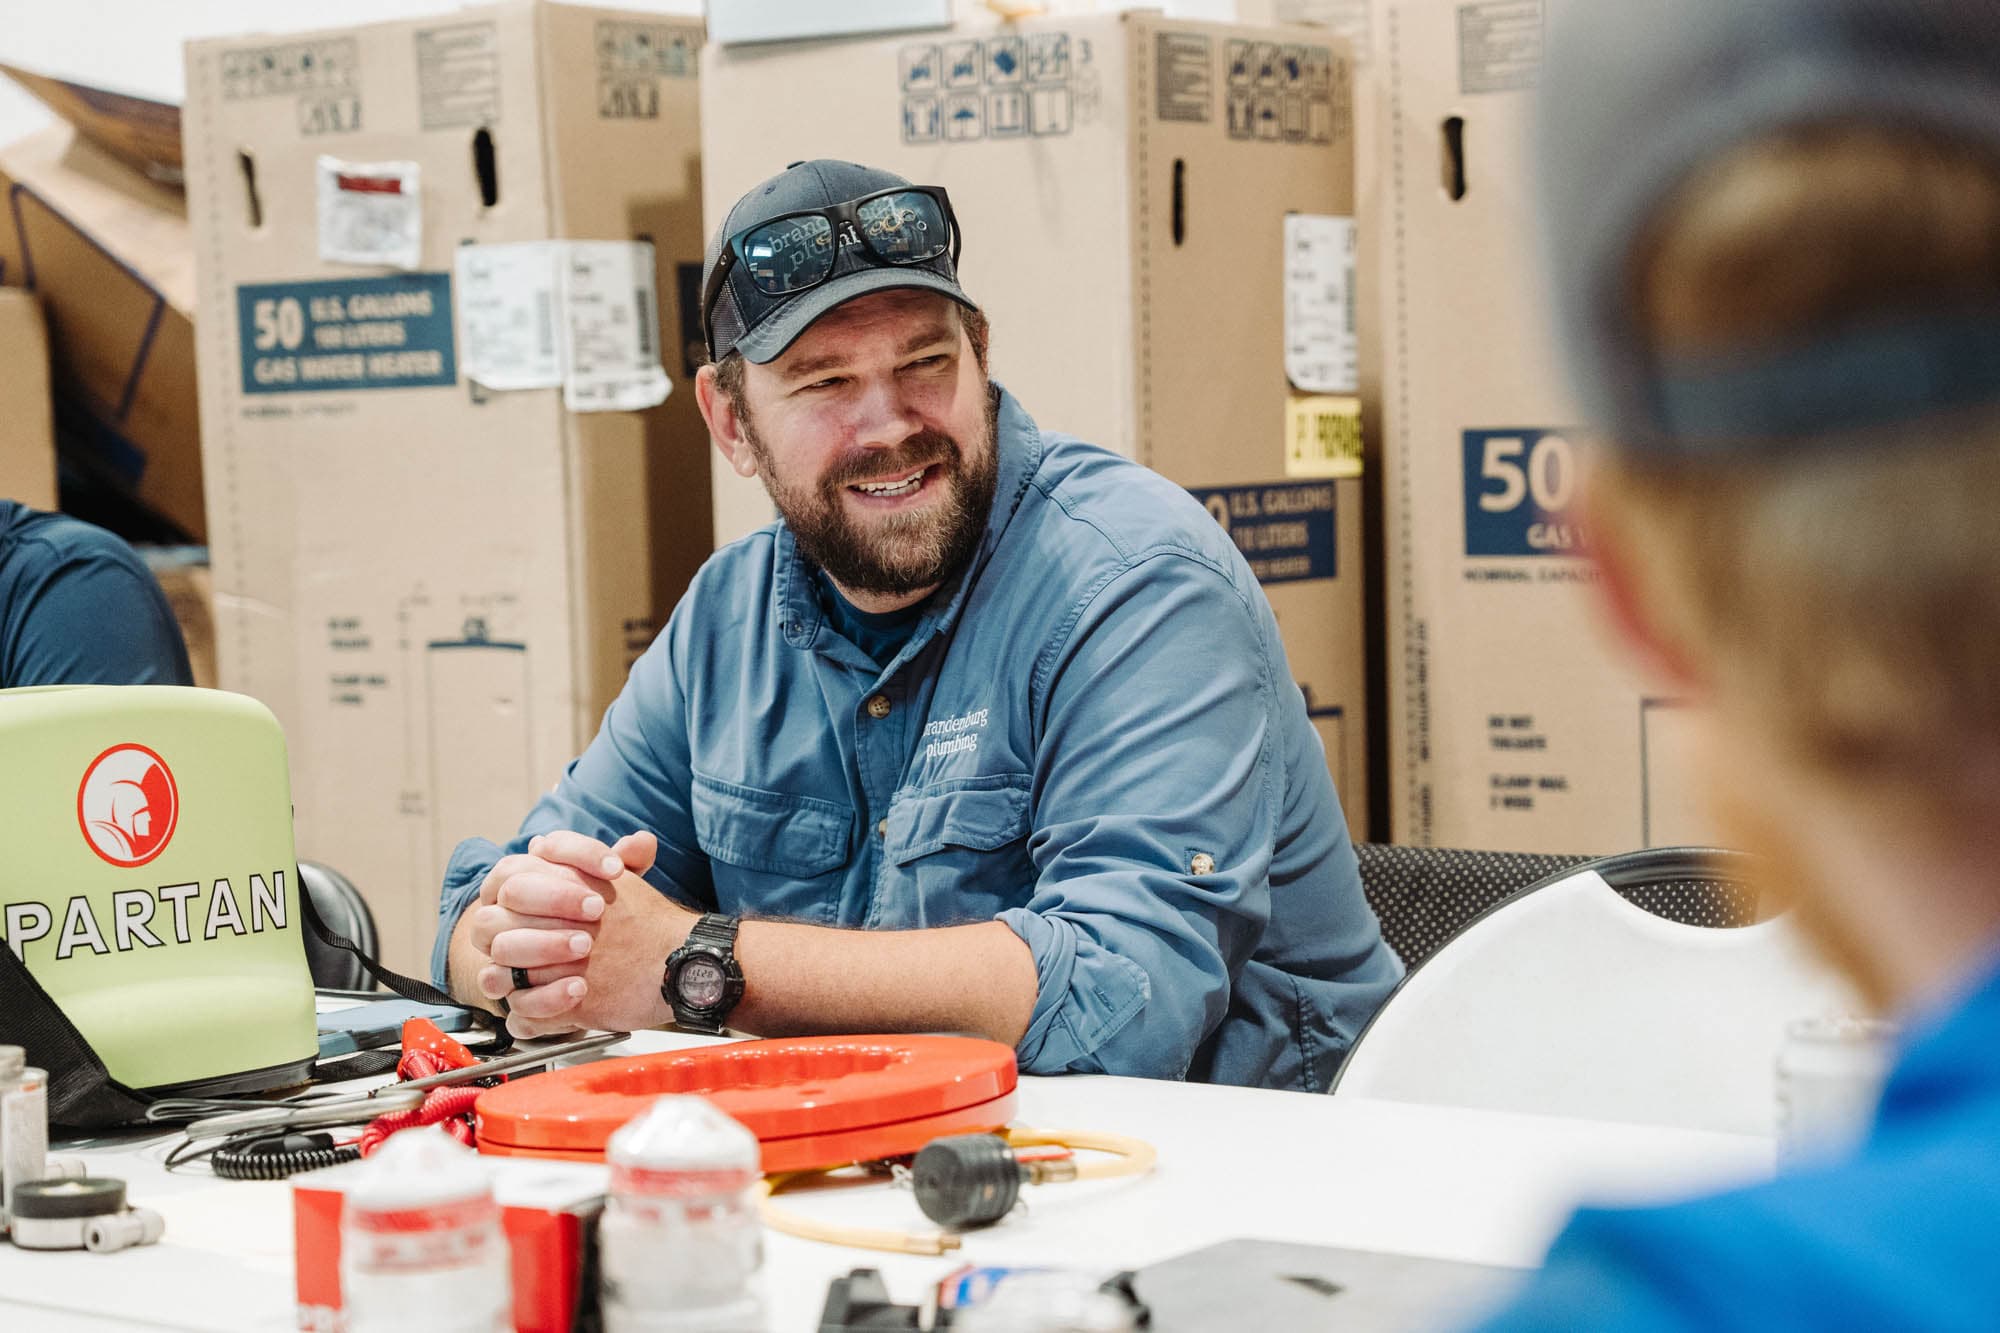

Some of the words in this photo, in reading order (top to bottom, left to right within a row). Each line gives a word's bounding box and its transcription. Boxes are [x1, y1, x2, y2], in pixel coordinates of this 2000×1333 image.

[347, 289, 433, 320] GALLONS
[253, 297, 304, 351] 50
[253, 356, 298, 385] GAS
[300, 353, 366, 382] WATER
[367, 350, 443, 379] HEATER
[1479, 435, 1575, 514] 50
[1261, 486, 1333, 514] GALLONS
[1526, 522, 1573, 549] GAS
[926, 732, 978, 761] plumbing
[4, 870, 288, 964] PARTAN
